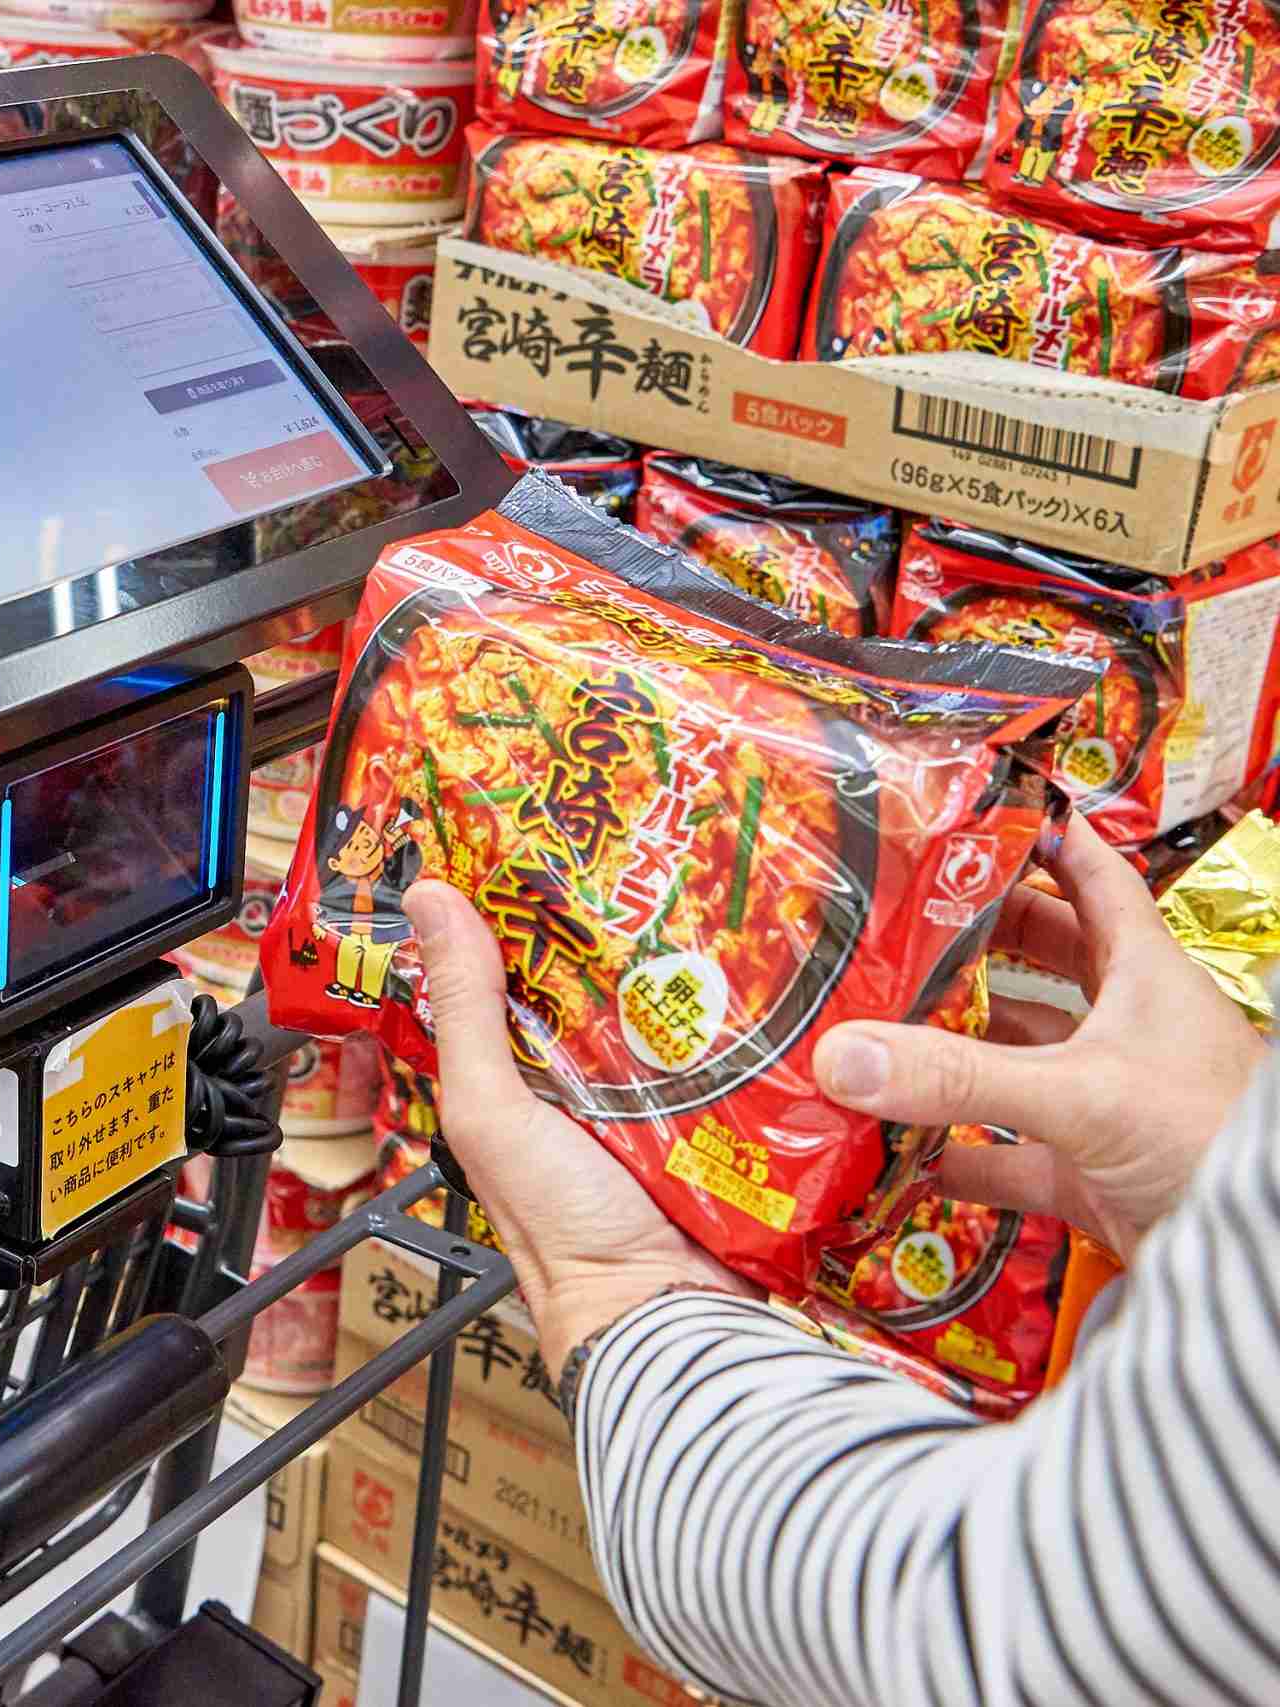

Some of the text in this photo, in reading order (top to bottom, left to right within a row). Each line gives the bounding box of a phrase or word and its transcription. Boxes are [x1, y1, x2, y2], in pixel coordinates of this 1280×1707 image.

[805, 0, 872, 136] 崎辛麺
[580, 152, 643, 276] 宮崎
[458, 298, 694, 406] 宮崎辛麺
[744, 400, 836, 438] 5食パック
[603, 702, 739, 940] チャルメラ
[630, 974, 707, 1048] 仕上げて
[663, 974, 708, 1018] 卵で
[49, 1084, 175, 1173] 取り外せます、重た
[51, 1051, 176, 1137] こちらのスキャナは
[49, 1123, 167, 1202] い商品に便利です。
